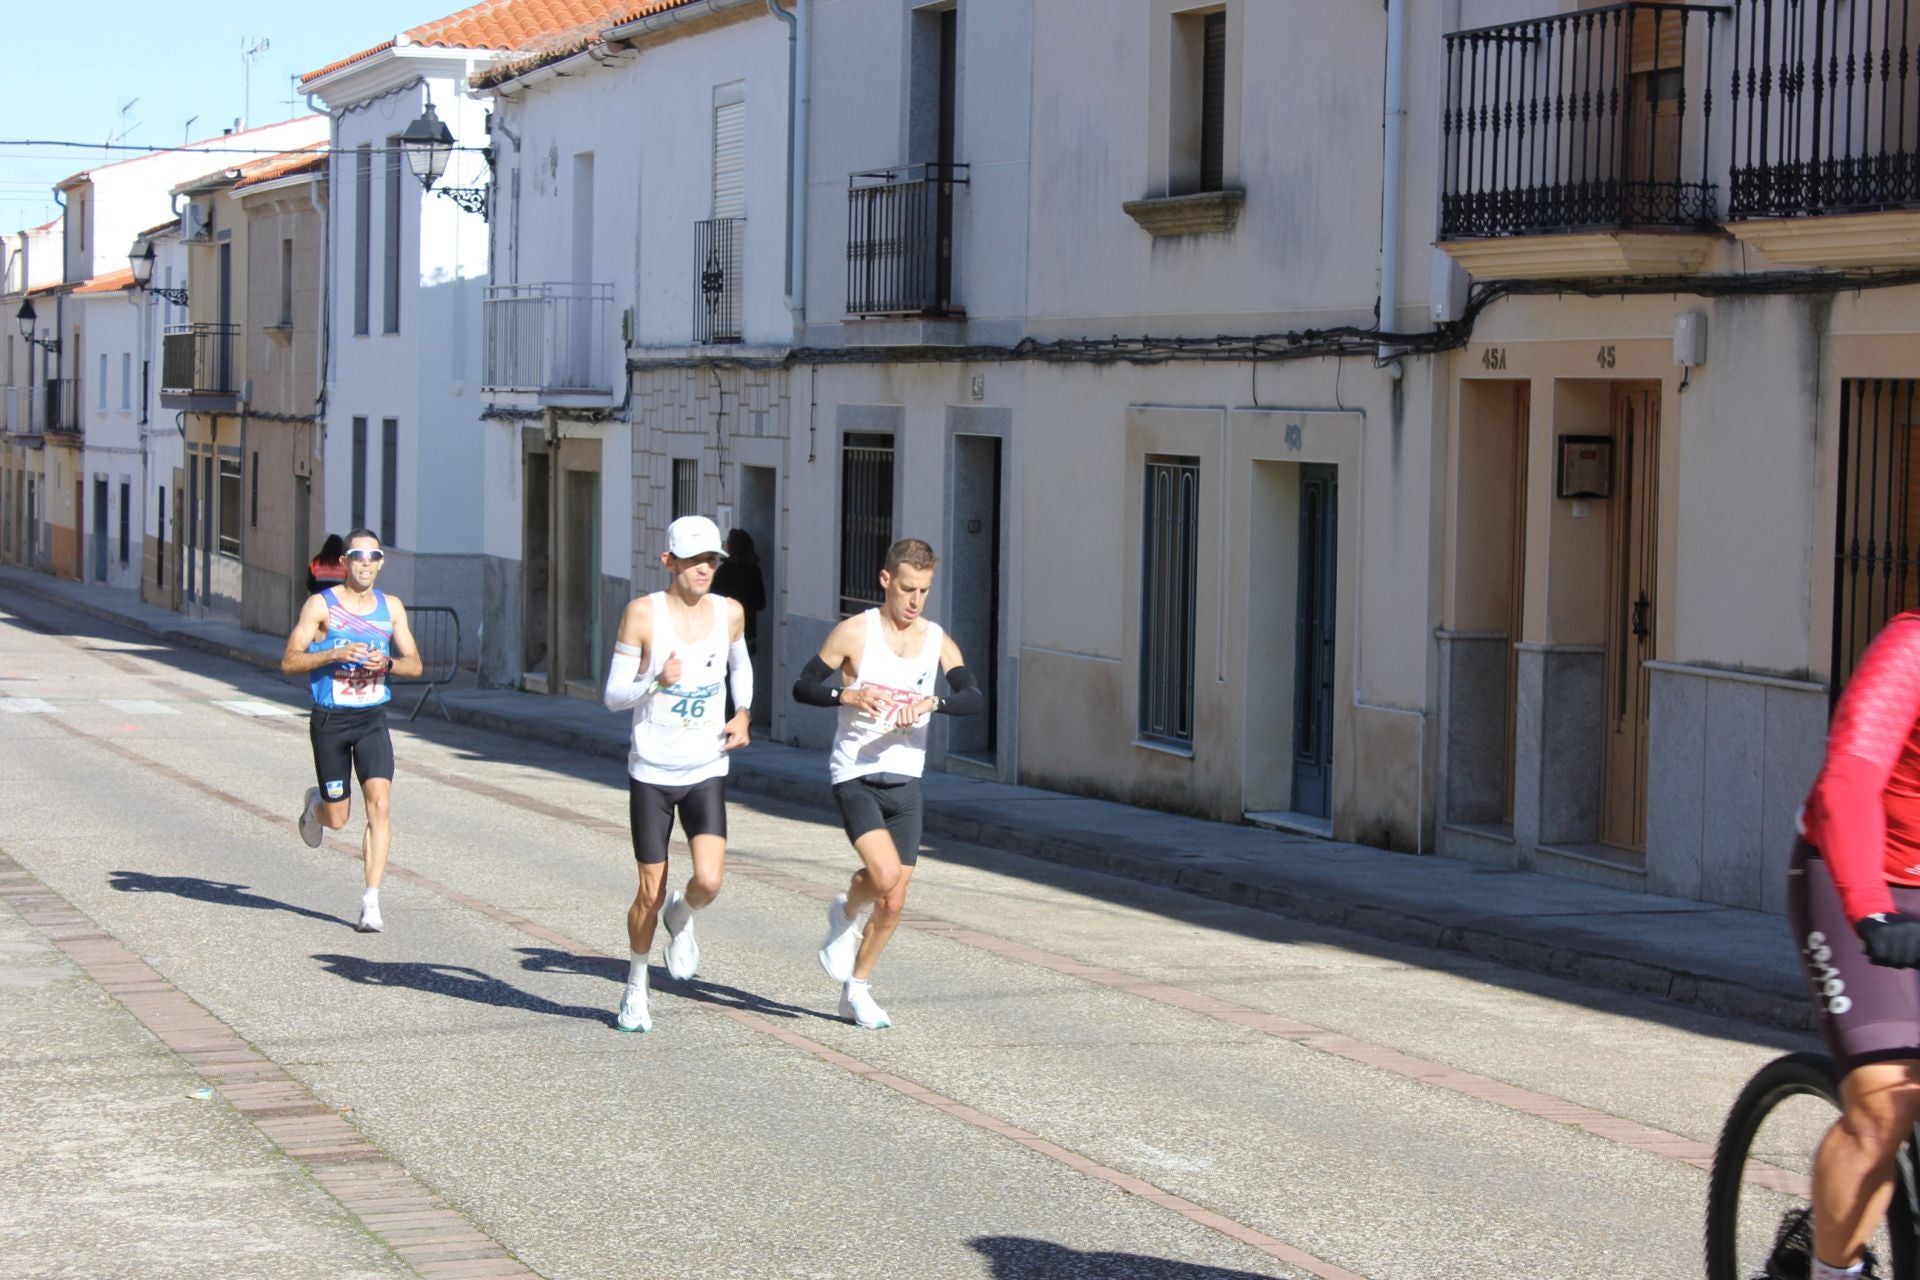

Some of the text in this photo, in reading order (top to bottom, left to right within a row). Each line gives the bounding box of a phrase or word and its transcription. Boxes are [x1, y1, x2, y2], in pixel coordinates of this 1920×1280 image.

[1482, 347, 1507, 370] 45A
[1597, 345, 1616, 369] 45
[671, 699, 706, 718] 46
